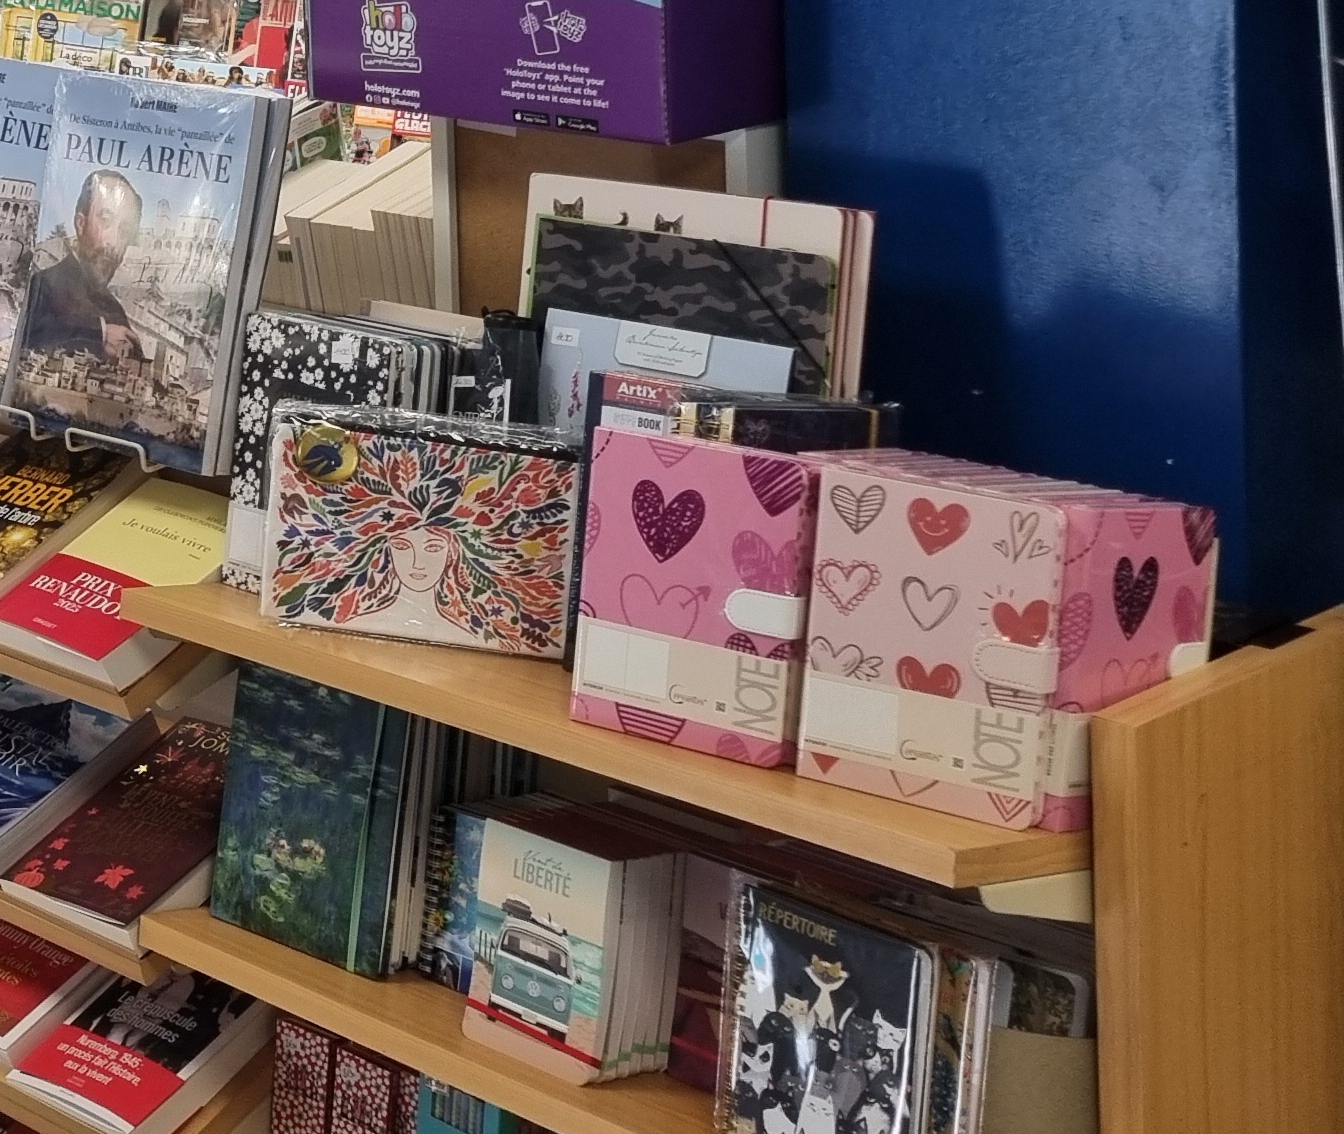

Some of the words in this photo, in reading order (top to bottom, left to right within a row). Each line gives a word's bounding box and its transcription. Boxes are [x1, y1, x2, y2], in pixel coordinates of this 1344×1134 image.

[516, 58, 556, 71] Download
[557, 63, 571, 72] the
[573, 64, 590, 74] free
[364, 80, 420, 98] holotoyz.com
[511, 80, 536, 90] phone
[548, 83, 571, 94] tablet
[65, 132, 131, 169] PAUL
[136, 143, 233, 185] ARÈNE
[637, 417, 661, 432] BOOK
[16, 464, 70, 485] BERNARD
[138, 522, 178, 542] voulais
[180, 536, 211, 554] vivre
[74, 570, 119, 595] PRIX
[972, 713, 1026, 794] NOTE
[512, 855, 572, 898] LIBERTÉ
[758, 900, 838, 947] RÉPERTOIRE
[132, 993, 198, 1032] crépuscule
[128, 1014, 180, 1044] hommes
